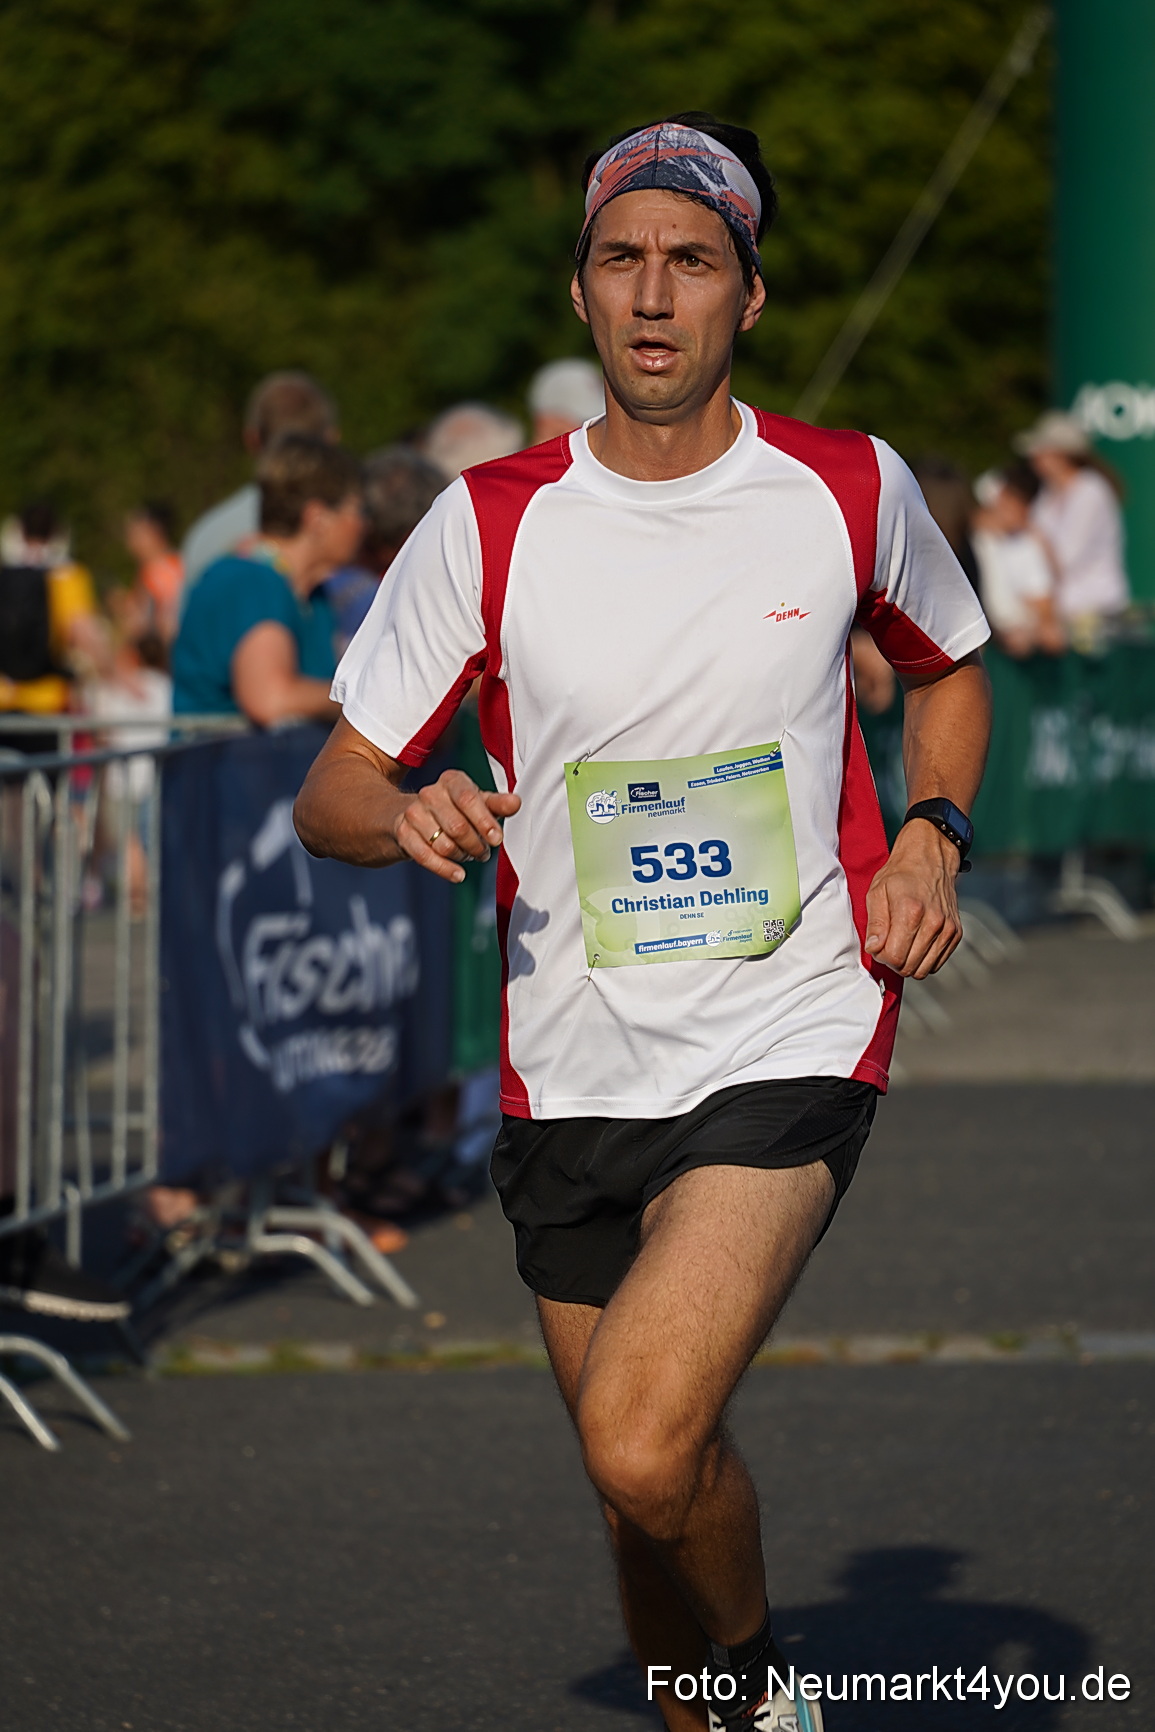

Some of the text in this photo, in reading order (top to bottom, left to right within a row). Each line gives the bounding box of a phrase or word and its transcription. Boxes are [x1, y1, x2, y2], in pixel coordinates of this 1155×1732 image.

[775, 607, 800, 622] DEHN
[621, 796, 686, 815] Firmenlauf
[647, 806, 686, 818] neumarkt
[630, 839, 732, 884] 533
[611, 887, 769, 914] Christian Dehling
[638, 938, 704, 953] firmenlauf.bayern
